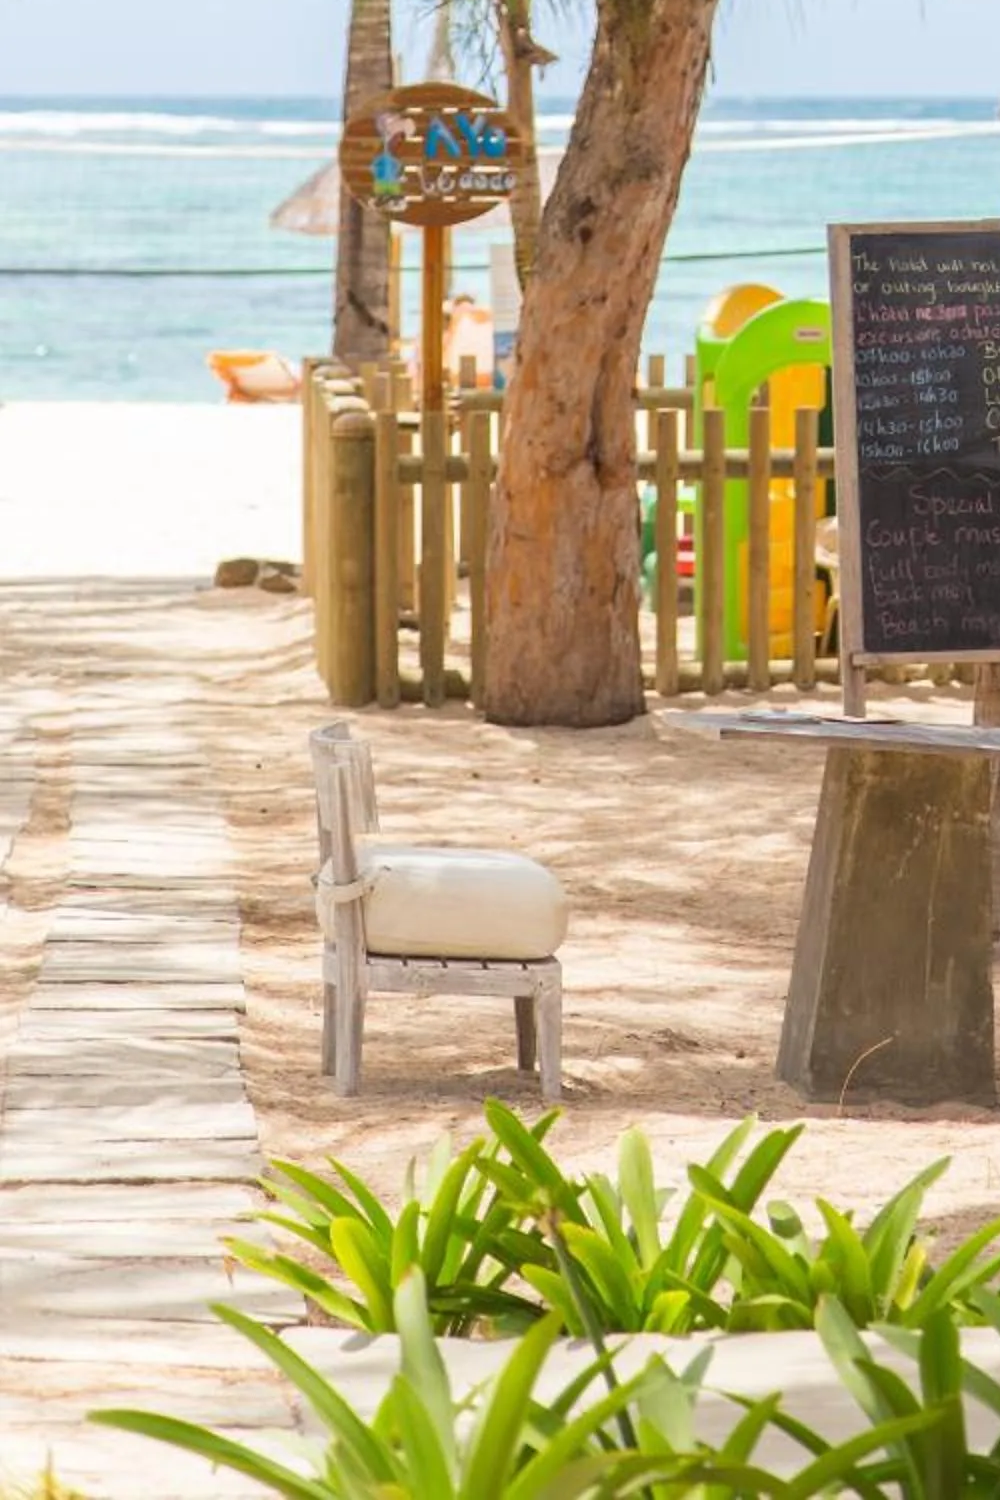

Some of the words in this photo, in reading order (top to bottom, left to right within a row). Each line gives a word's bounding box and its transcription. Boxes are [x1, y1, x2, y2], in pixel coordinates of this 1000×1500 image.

[853, 253, 880, 272] The
[937, 257, 964, 273] will
[972, 257, 999, 273] not
[853, 282, 870, 294] or
[881, 280, 936, 304] outing
